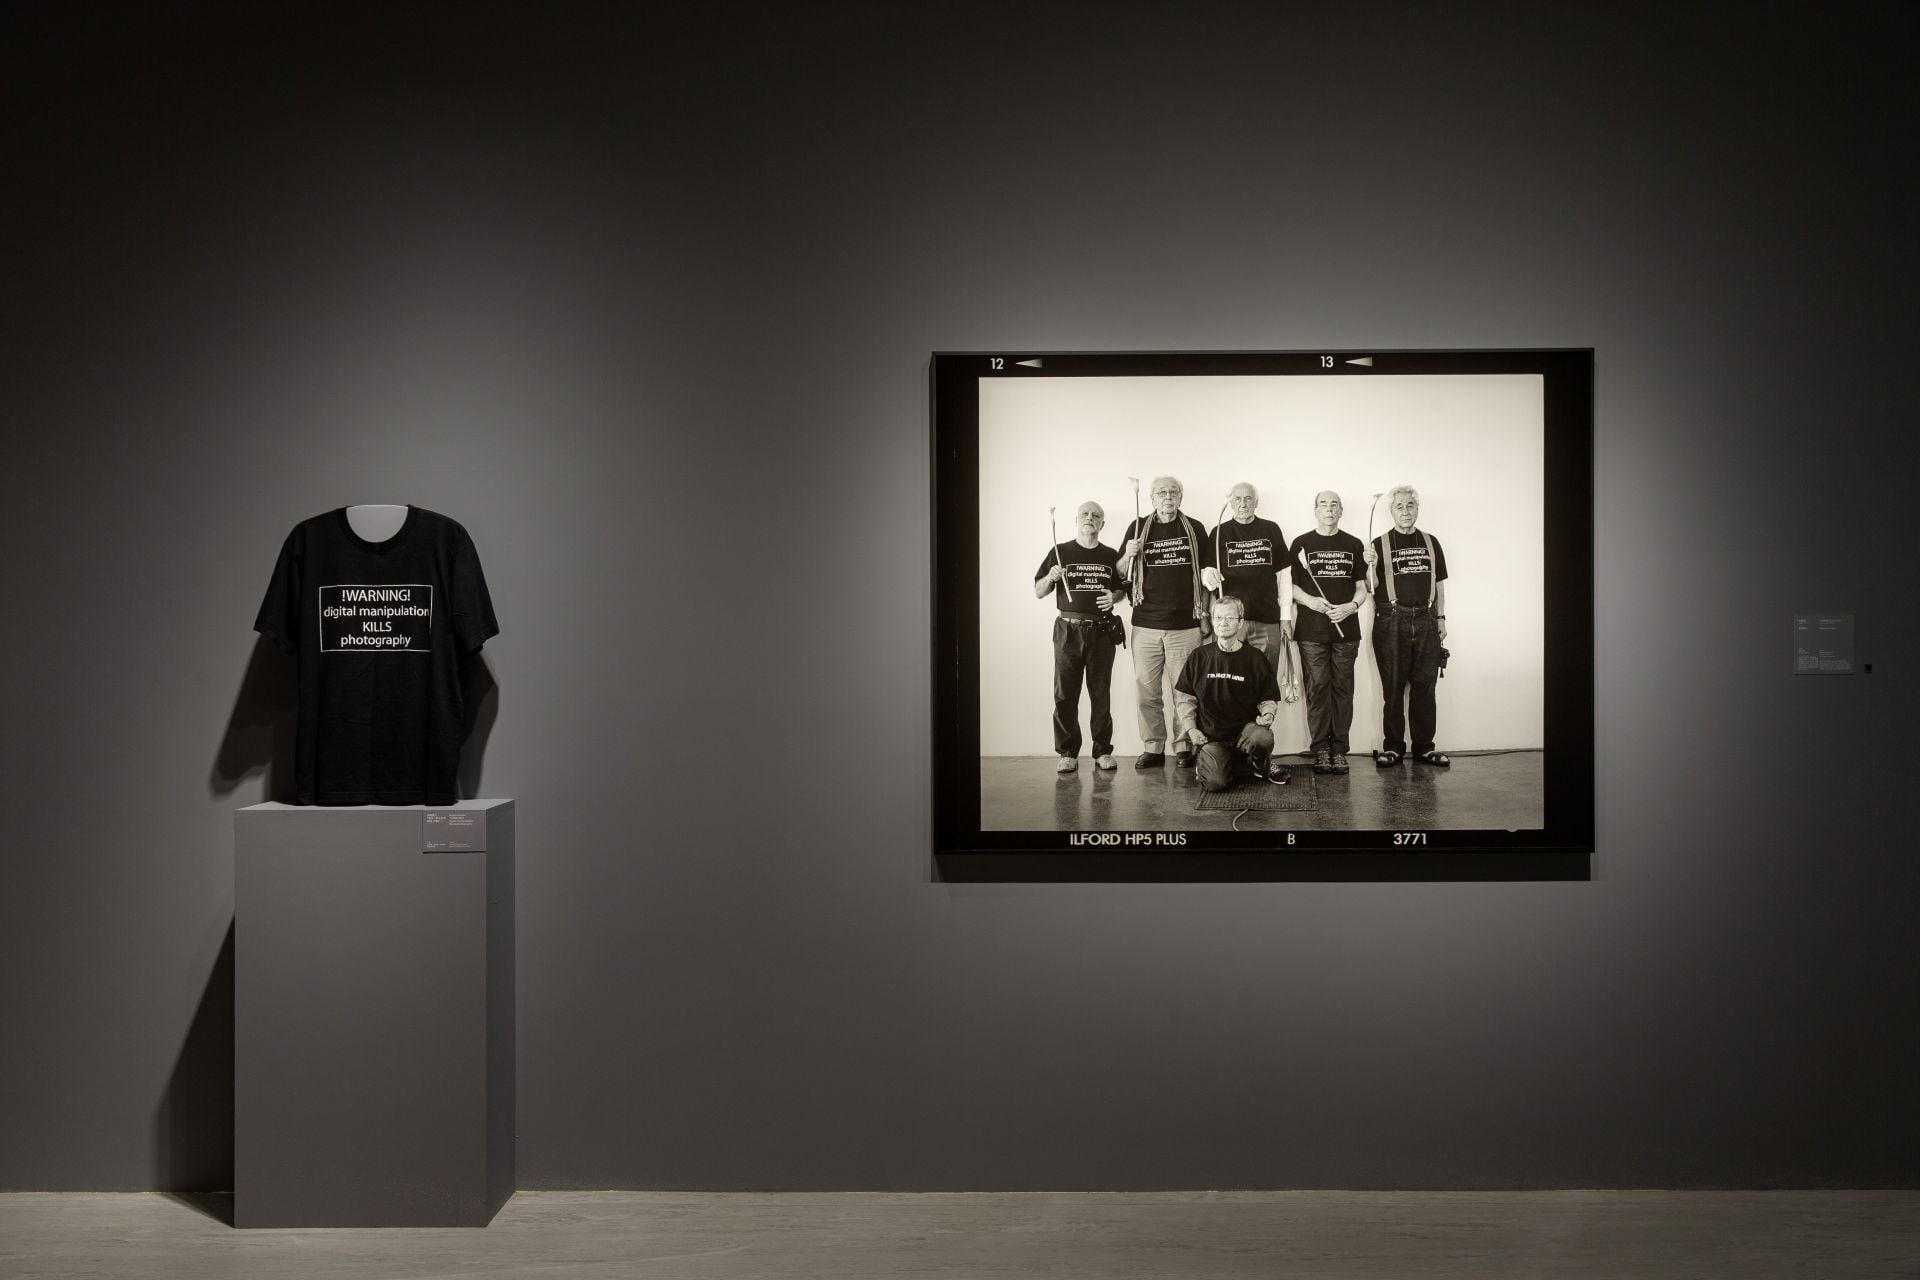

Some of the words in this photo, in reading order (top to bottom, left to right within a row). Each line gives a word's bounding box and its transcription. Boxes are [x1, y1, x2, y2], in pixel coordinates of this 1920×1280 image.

[990, 357, 1004, 370] 12
[1320, 355, 1334, 368] 13
[342, 589, 411, 602] !WARNING!
[323, 605, 356, 619] digital
[359, 604, 430, 618] manipulation
[362, 621, 392, 633] KILLS
[340, 634, 412, 648] photography
[1070, 833, 1121, 846] ILFORD
[1125, 833, 1152, 846] HP5
[1156, 833, 1187, 846] PLUS
[1287, 833, 1296, 845] B
[1393, 833, 1427, 845] 3771
